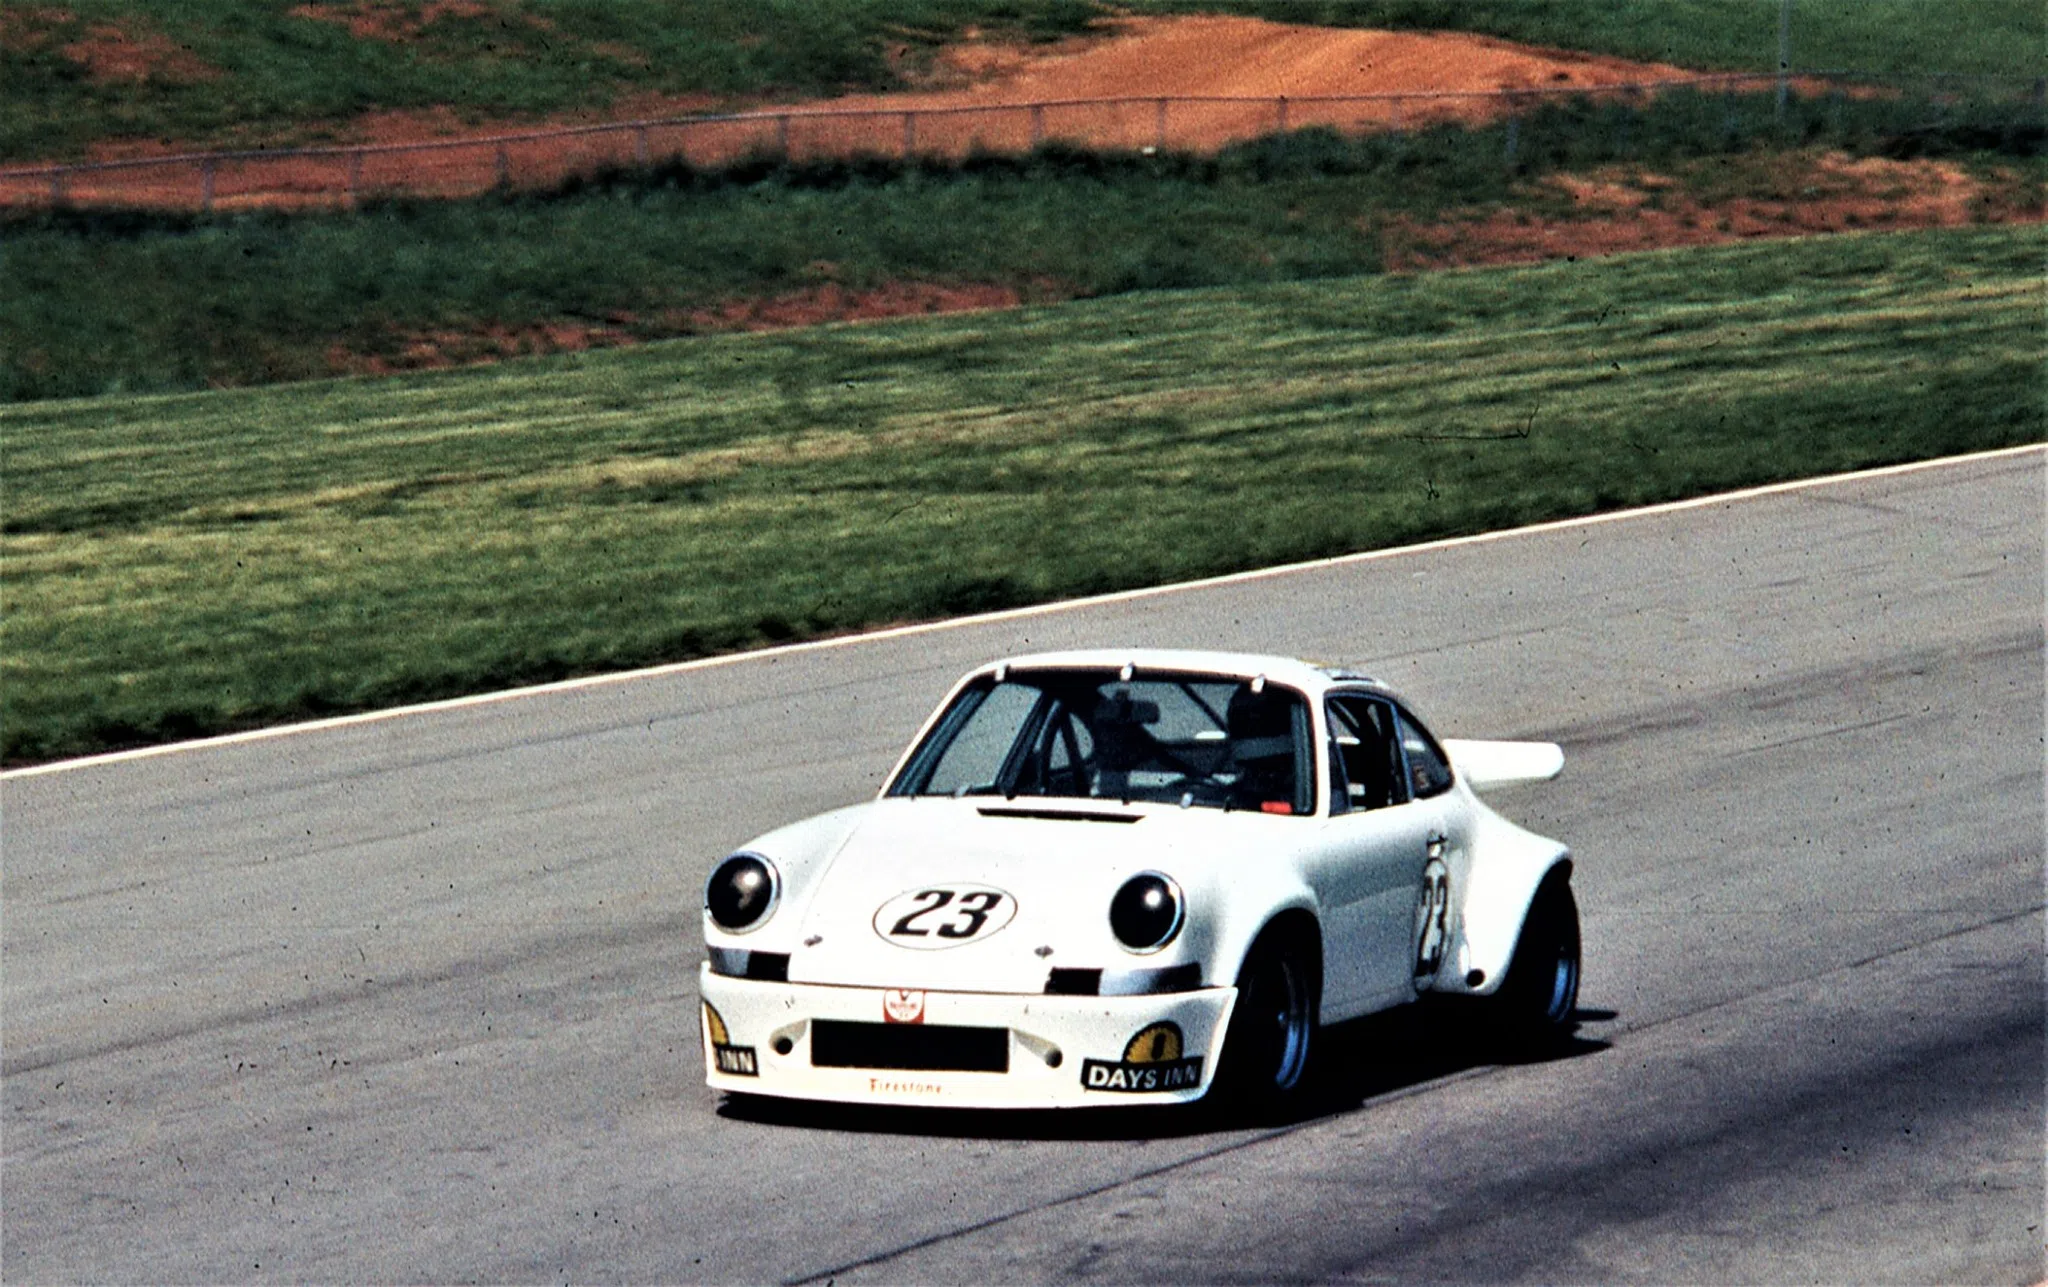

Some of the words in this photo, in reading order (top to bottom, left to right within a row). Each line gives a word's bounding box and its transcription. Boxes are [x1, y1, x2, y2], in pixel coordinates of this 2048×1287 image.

[889, 890, 1003, 939] 23
[869, 1078, 942, 1094] Firestone
[1087, 1064, 1157, 1090] DAYS
[1163, 1063, 1198, 1087] INN
